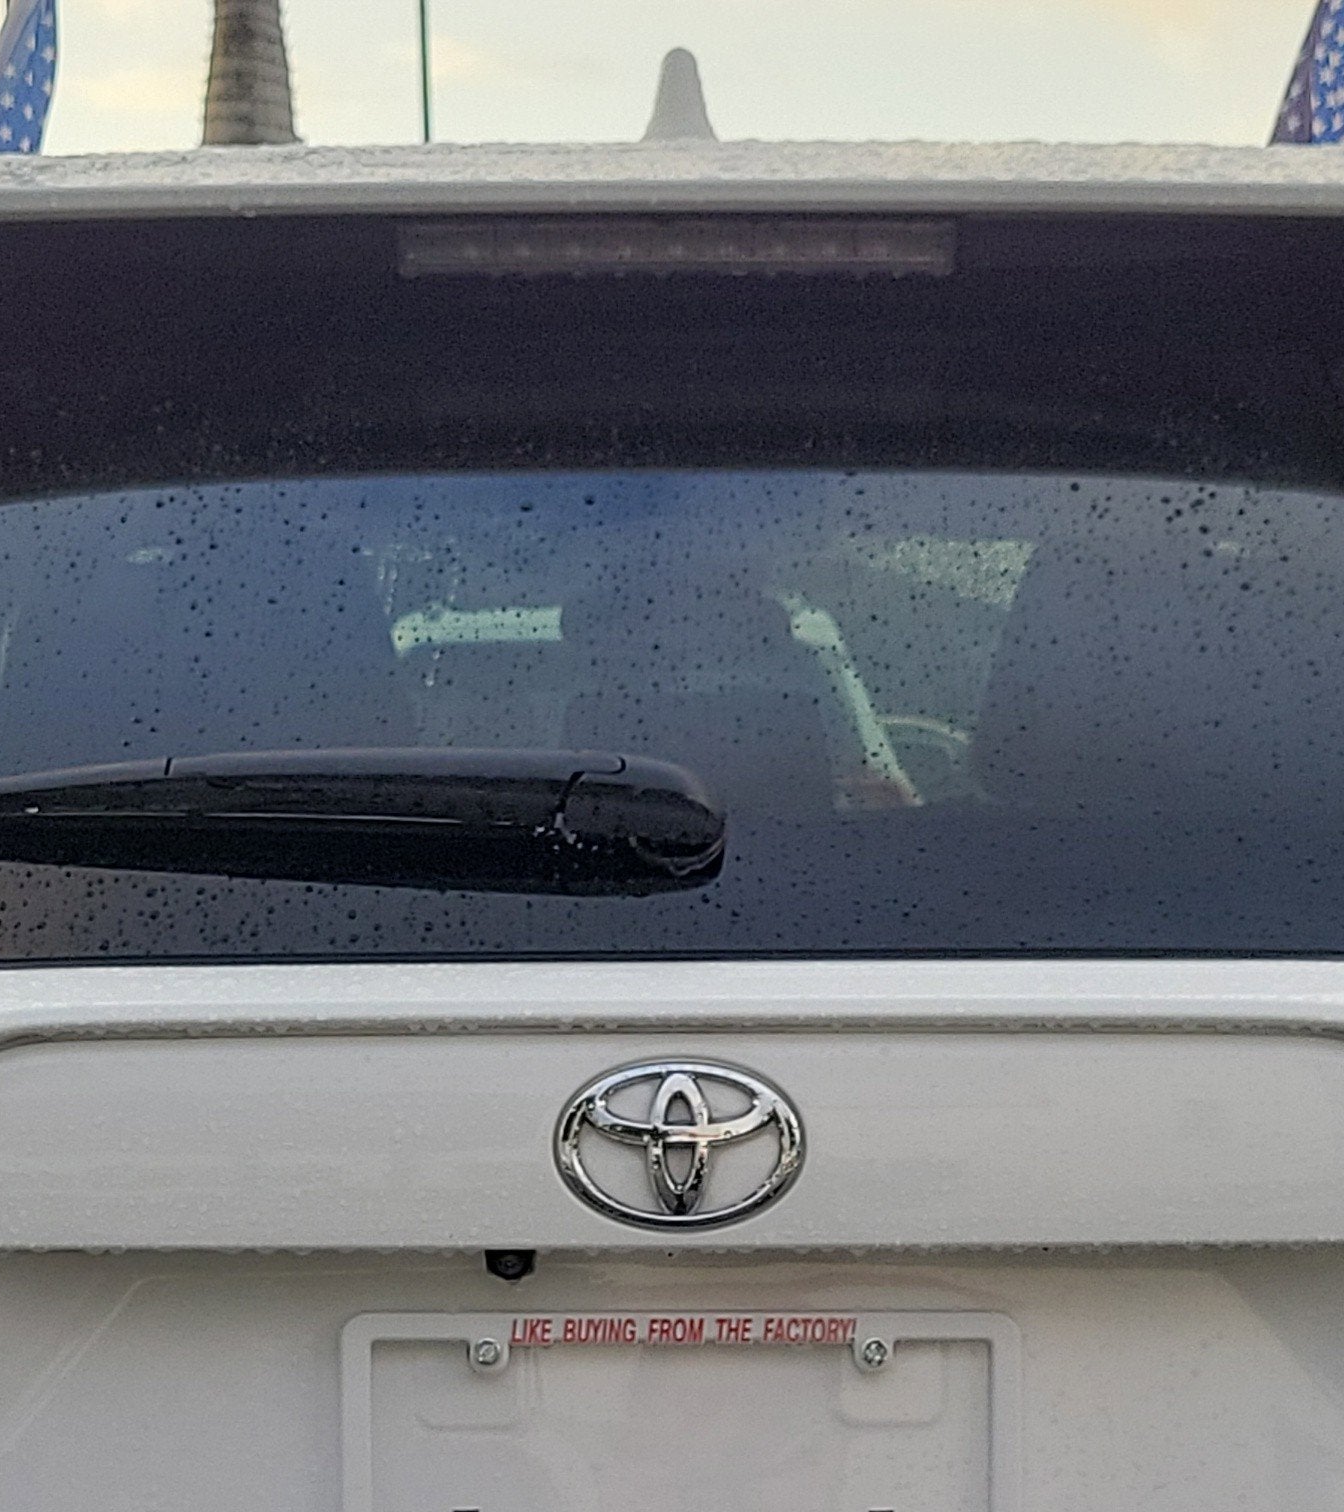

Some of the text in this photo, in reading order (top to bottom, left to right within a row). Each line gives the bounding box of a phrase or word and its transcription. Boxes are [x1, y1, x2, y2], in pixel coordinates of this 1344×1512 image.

[510, 1317, 858, 1343] LIKE BUYING FROM THE FACTORY!
